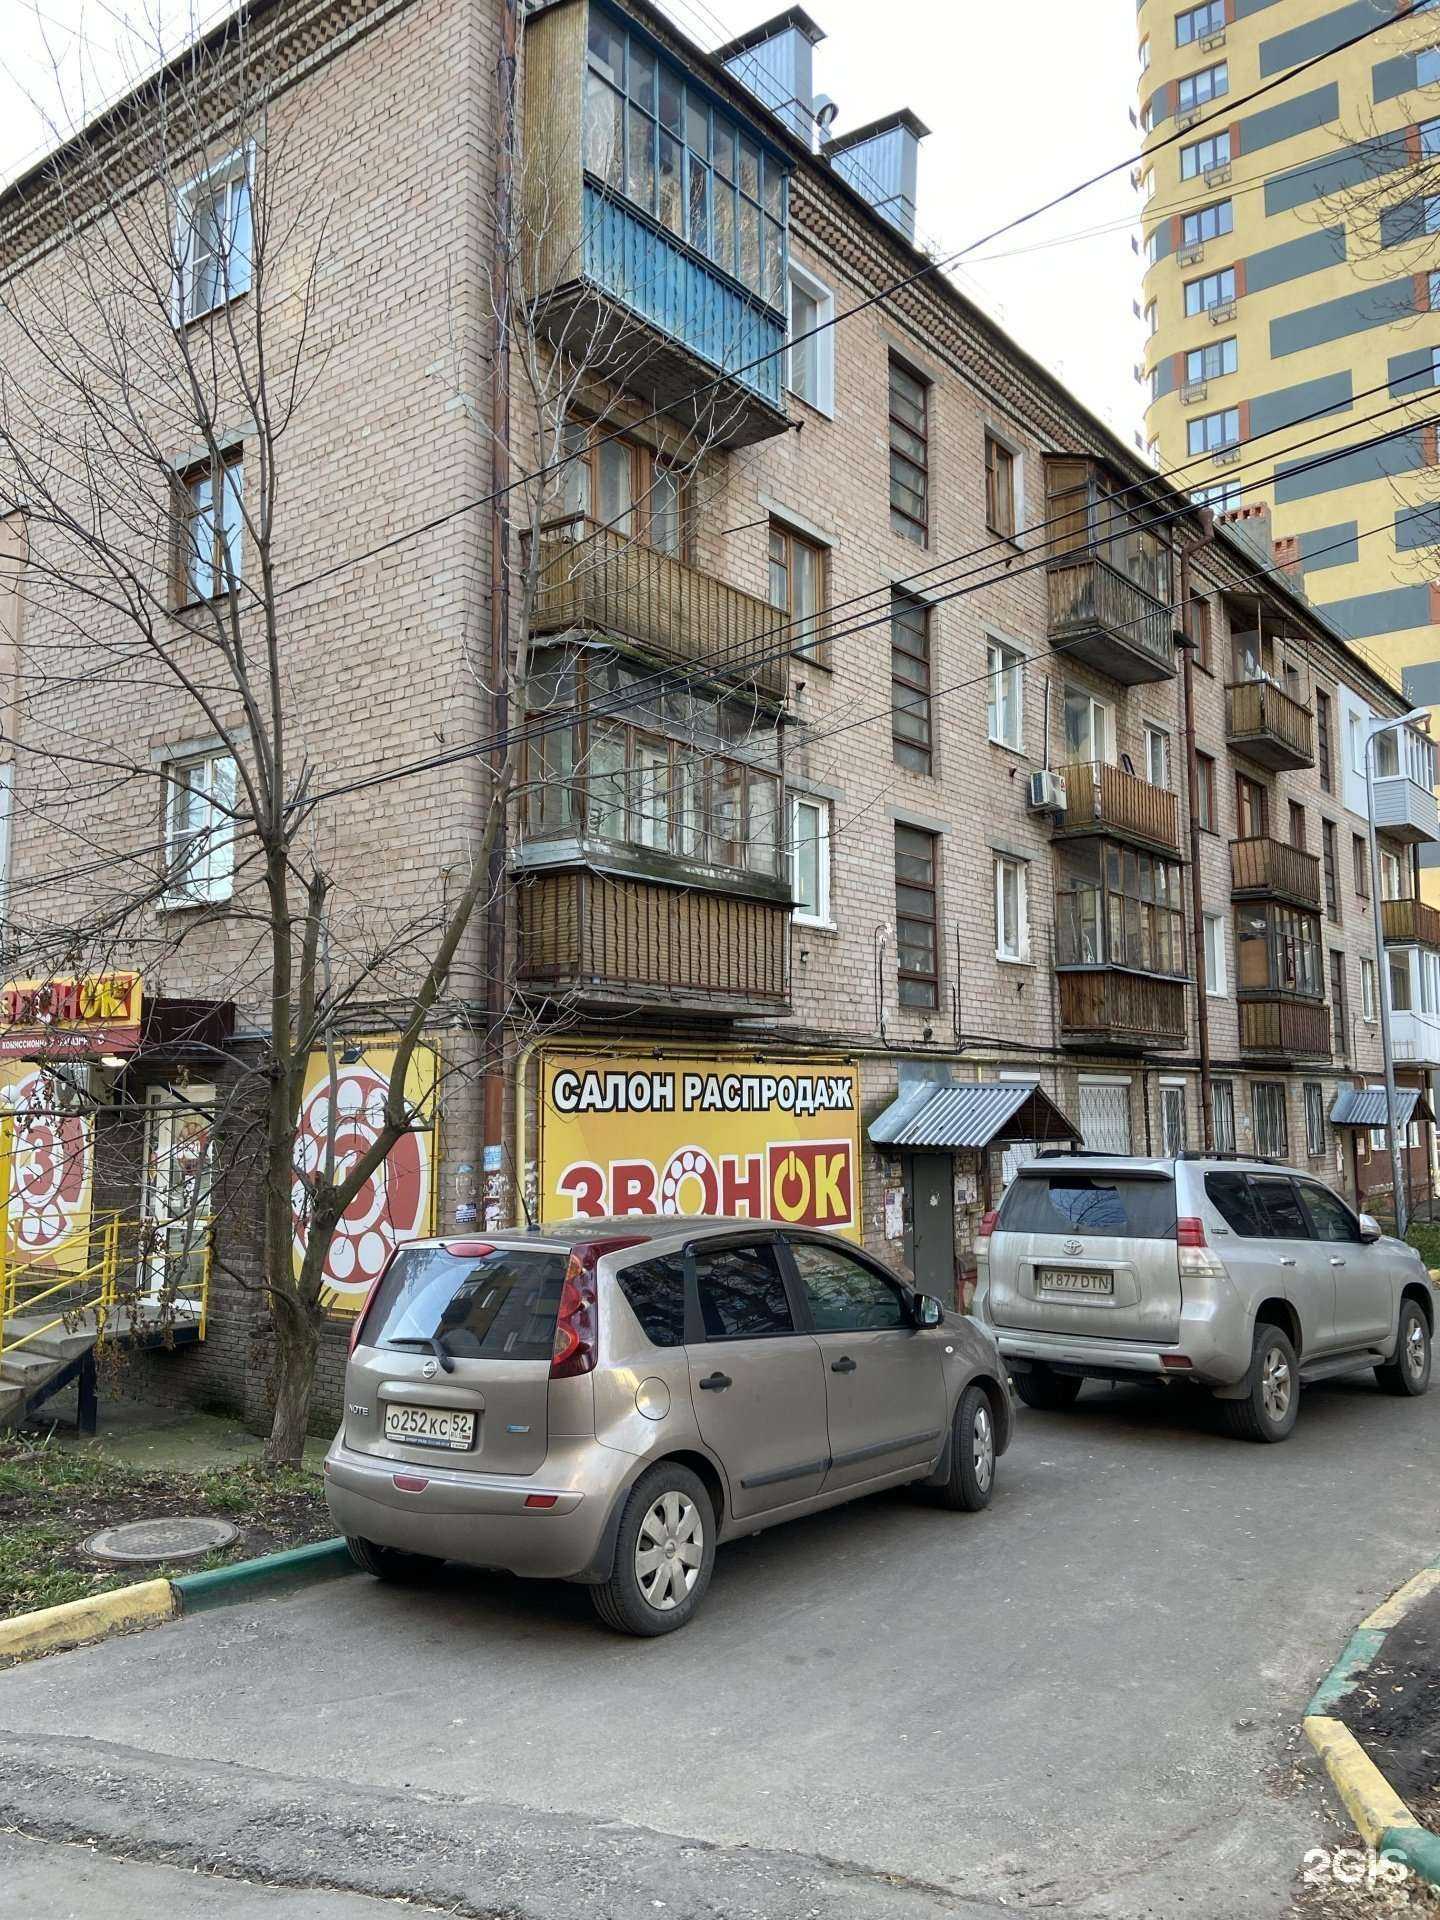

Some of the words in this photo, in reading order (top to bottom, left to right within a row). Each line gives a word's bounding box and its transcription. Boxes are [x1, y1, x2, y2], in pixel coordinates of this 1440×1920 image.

[2, 1039, 54, 1050] КОМИССИОНН
[552, 1069, 676, 1113] САЛОН
[682, 1073, 855, 1117] РАСПРОДАЖ
[557, 1144, 850, 1223] ЗВОНОК
